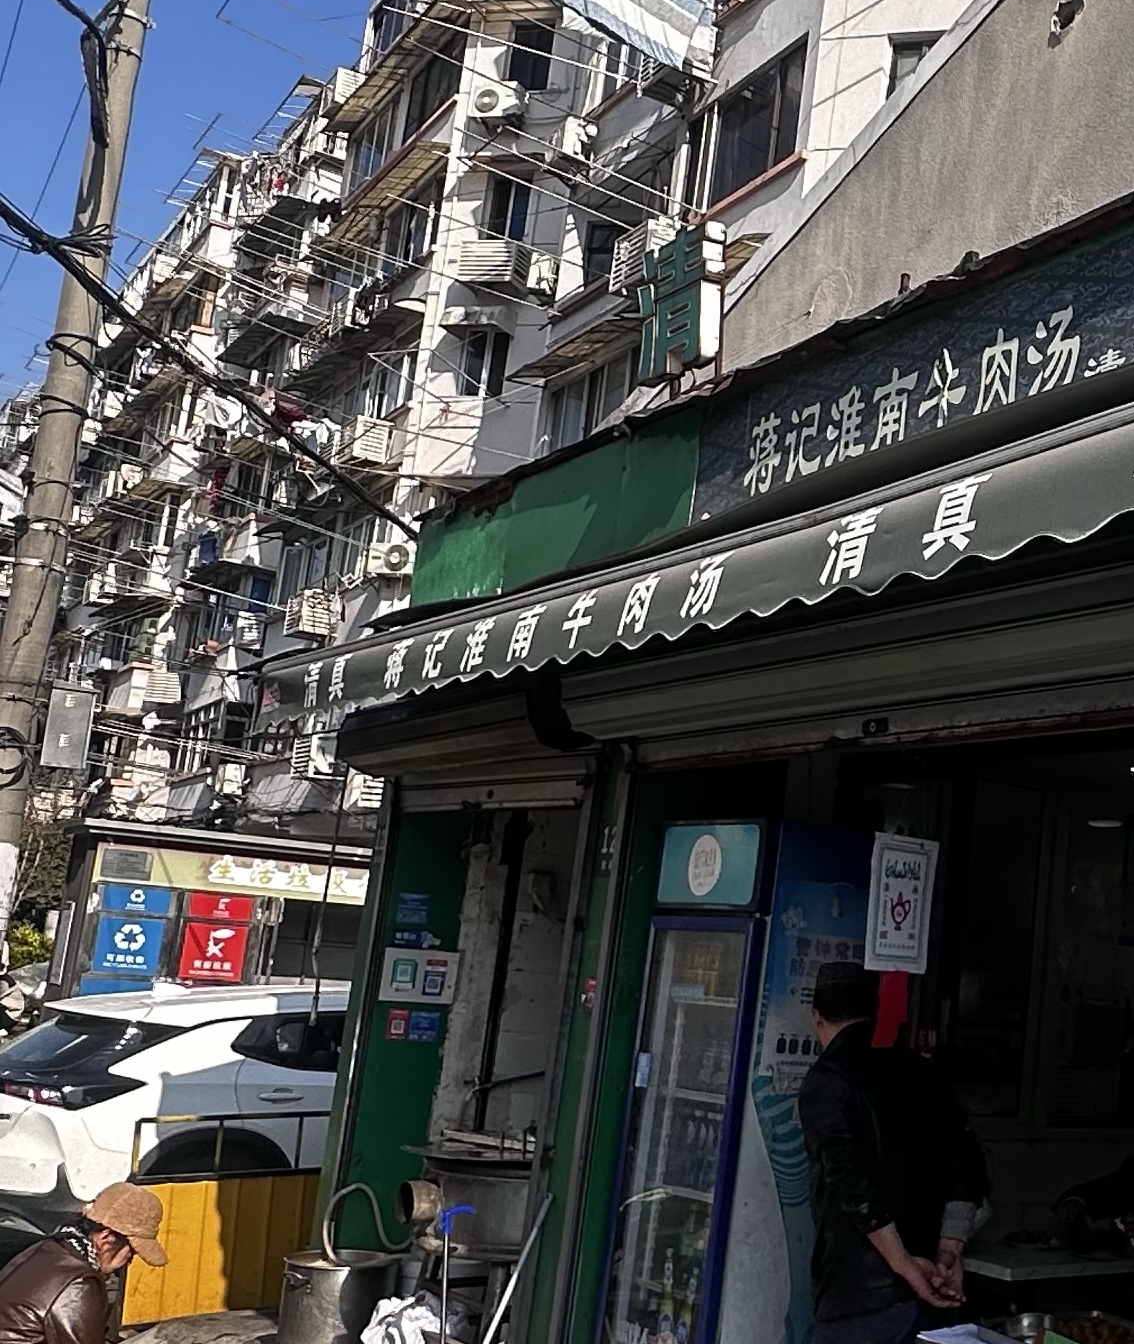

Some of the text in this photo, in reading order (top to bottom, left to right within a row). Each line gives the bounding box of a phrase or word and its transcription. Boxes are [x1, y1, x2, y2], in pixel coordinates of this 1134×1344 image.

[638, 222, 727, 379] 清
[743, 305, 1081, 497] 蒋记淮南牛肉汤
[384, 551, 735, 690] 蒋记淮南牛肉汤
[819, 472, 994, 586] 清真
